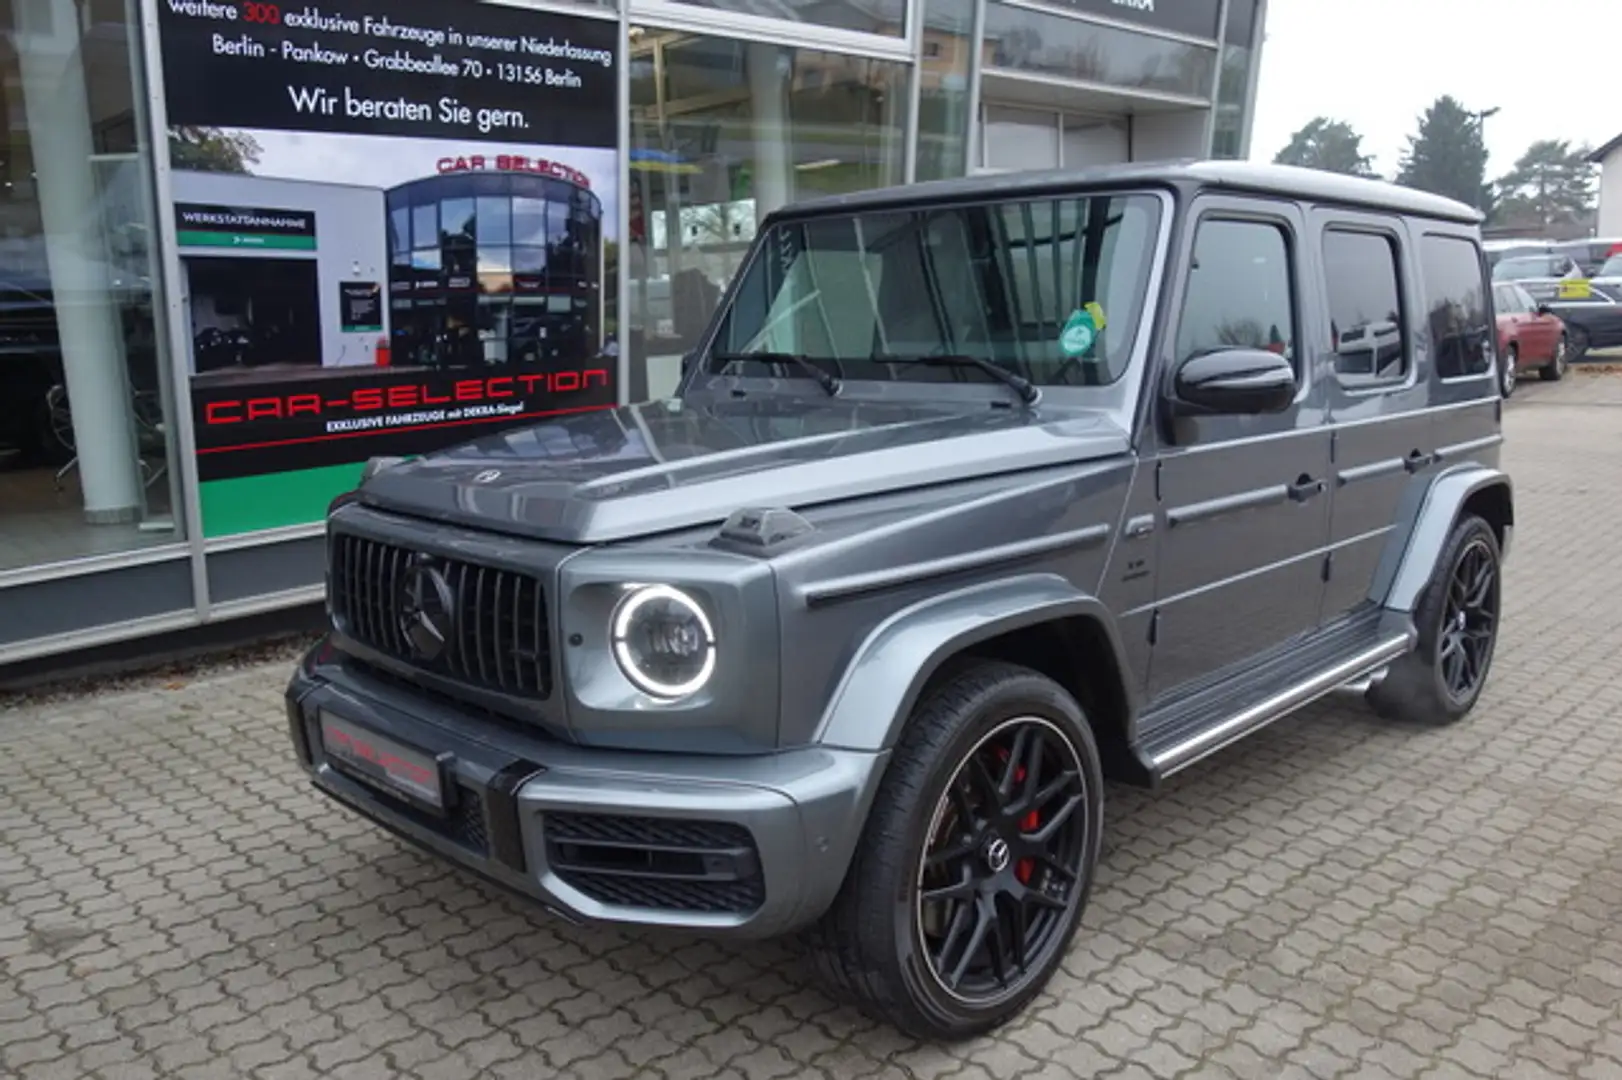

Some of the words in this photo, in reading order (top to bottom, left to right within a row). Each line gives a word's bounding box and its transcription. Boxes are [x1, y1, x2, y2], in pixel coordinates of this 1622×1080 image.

[242, 1, 281, 25] 300
[284, 7, 360, 34] exklusive
[364, 16, 446, 47] Fahrzeuge
[448, 28, 463, 44] in
[466, 35, 518, 51] unserer
[520, 36, 613, 67] Niederlassung
[212, 33, 265, 57] Berlin
[282, 41, 349, 65] Pankow
[364, 49, 460, 77] Grabbeallee
[462, 59, 484, 78] 70
[497, 62, 544, 85] 13156
[545, 68, 583, 89] Berlin
[287, 85, 339, 116] Wir
[344, 86, 433, 121] beraten
[438, 97, 473, 125] Sie
[476, 108, 530, 133] gern.
[436, 155, 486, 174] CAR
[205, 369, 609, 425] CAR-SELECTION
[326, 416, 384, 433] EXKLUSIVE
